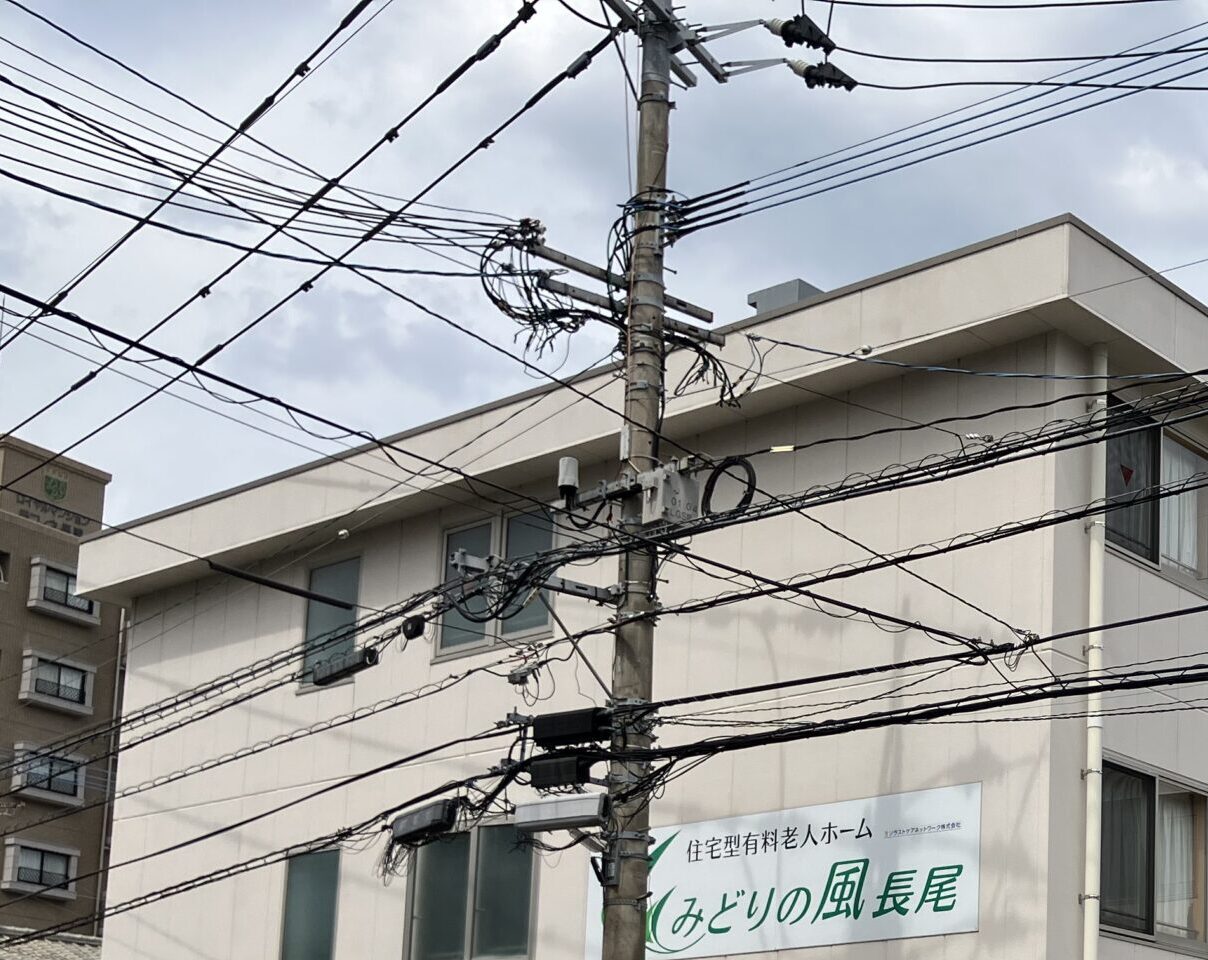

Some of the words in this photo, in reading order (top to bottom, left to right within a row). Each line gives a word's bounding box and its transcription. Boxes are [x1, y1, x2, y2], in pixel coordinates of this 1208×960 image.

[687, 818, 873, 863] 住宅型有料老人ホーム
